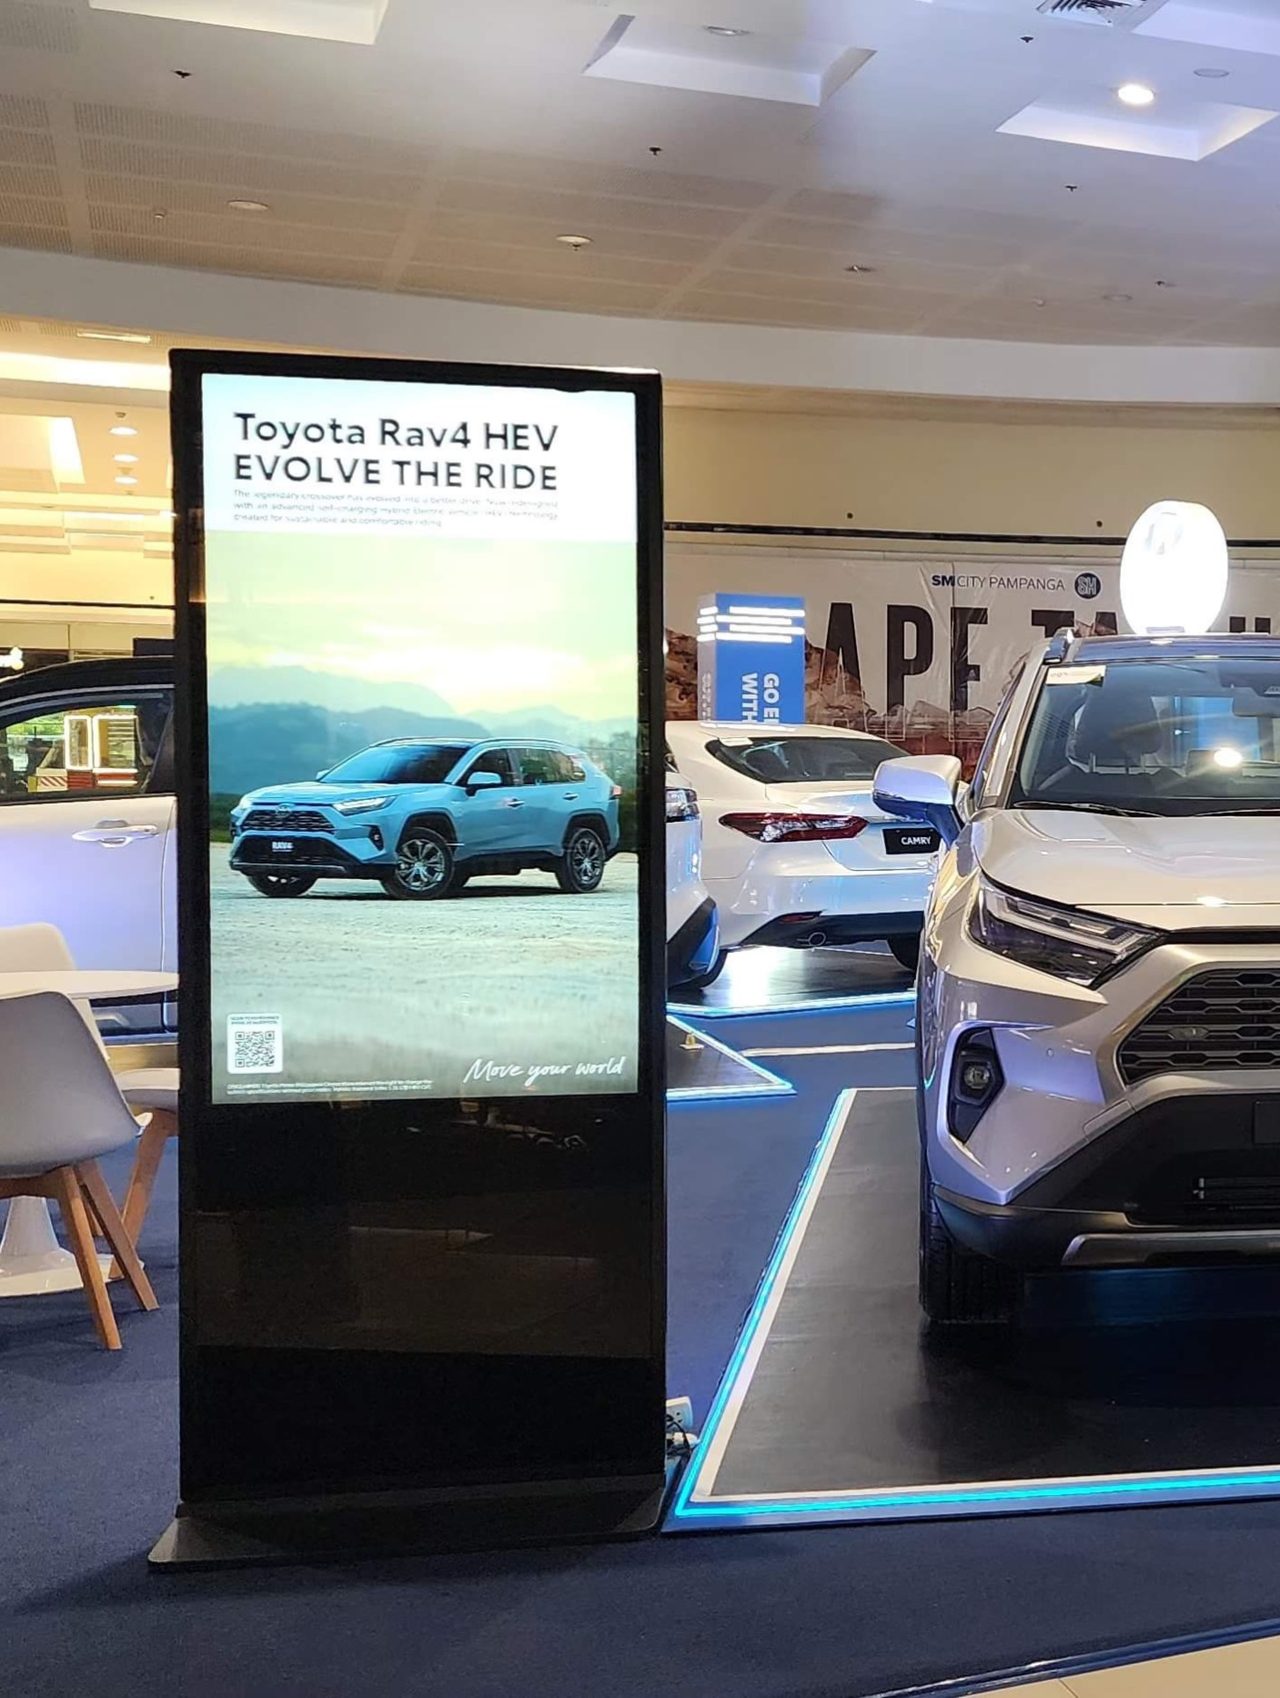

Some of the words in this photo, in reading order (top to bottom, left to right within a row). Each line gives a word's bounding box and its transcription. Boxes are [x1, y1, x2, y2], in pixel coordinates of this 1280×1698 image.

[234, 412, 365, 449] Toyota
[379, 418, 471, 449] Rav4
[484, 422, 558, 451] HEV
[234, 453, 381, 485] EVOLVE
[392, 459, 462, 488] THE
[475, 462, 557, 491] RIDE
[989, 577, 1065, 591] PAMPANGA
[742, 672, 758, 723] WITH
[763, 673, 780, 704] GO
[901, 836, 931, 845] CAMRY
[463, 1058, 524, 1083] Move
[524, 1064, 572, 1087] your
[576, 1056, 626, 1075] world
